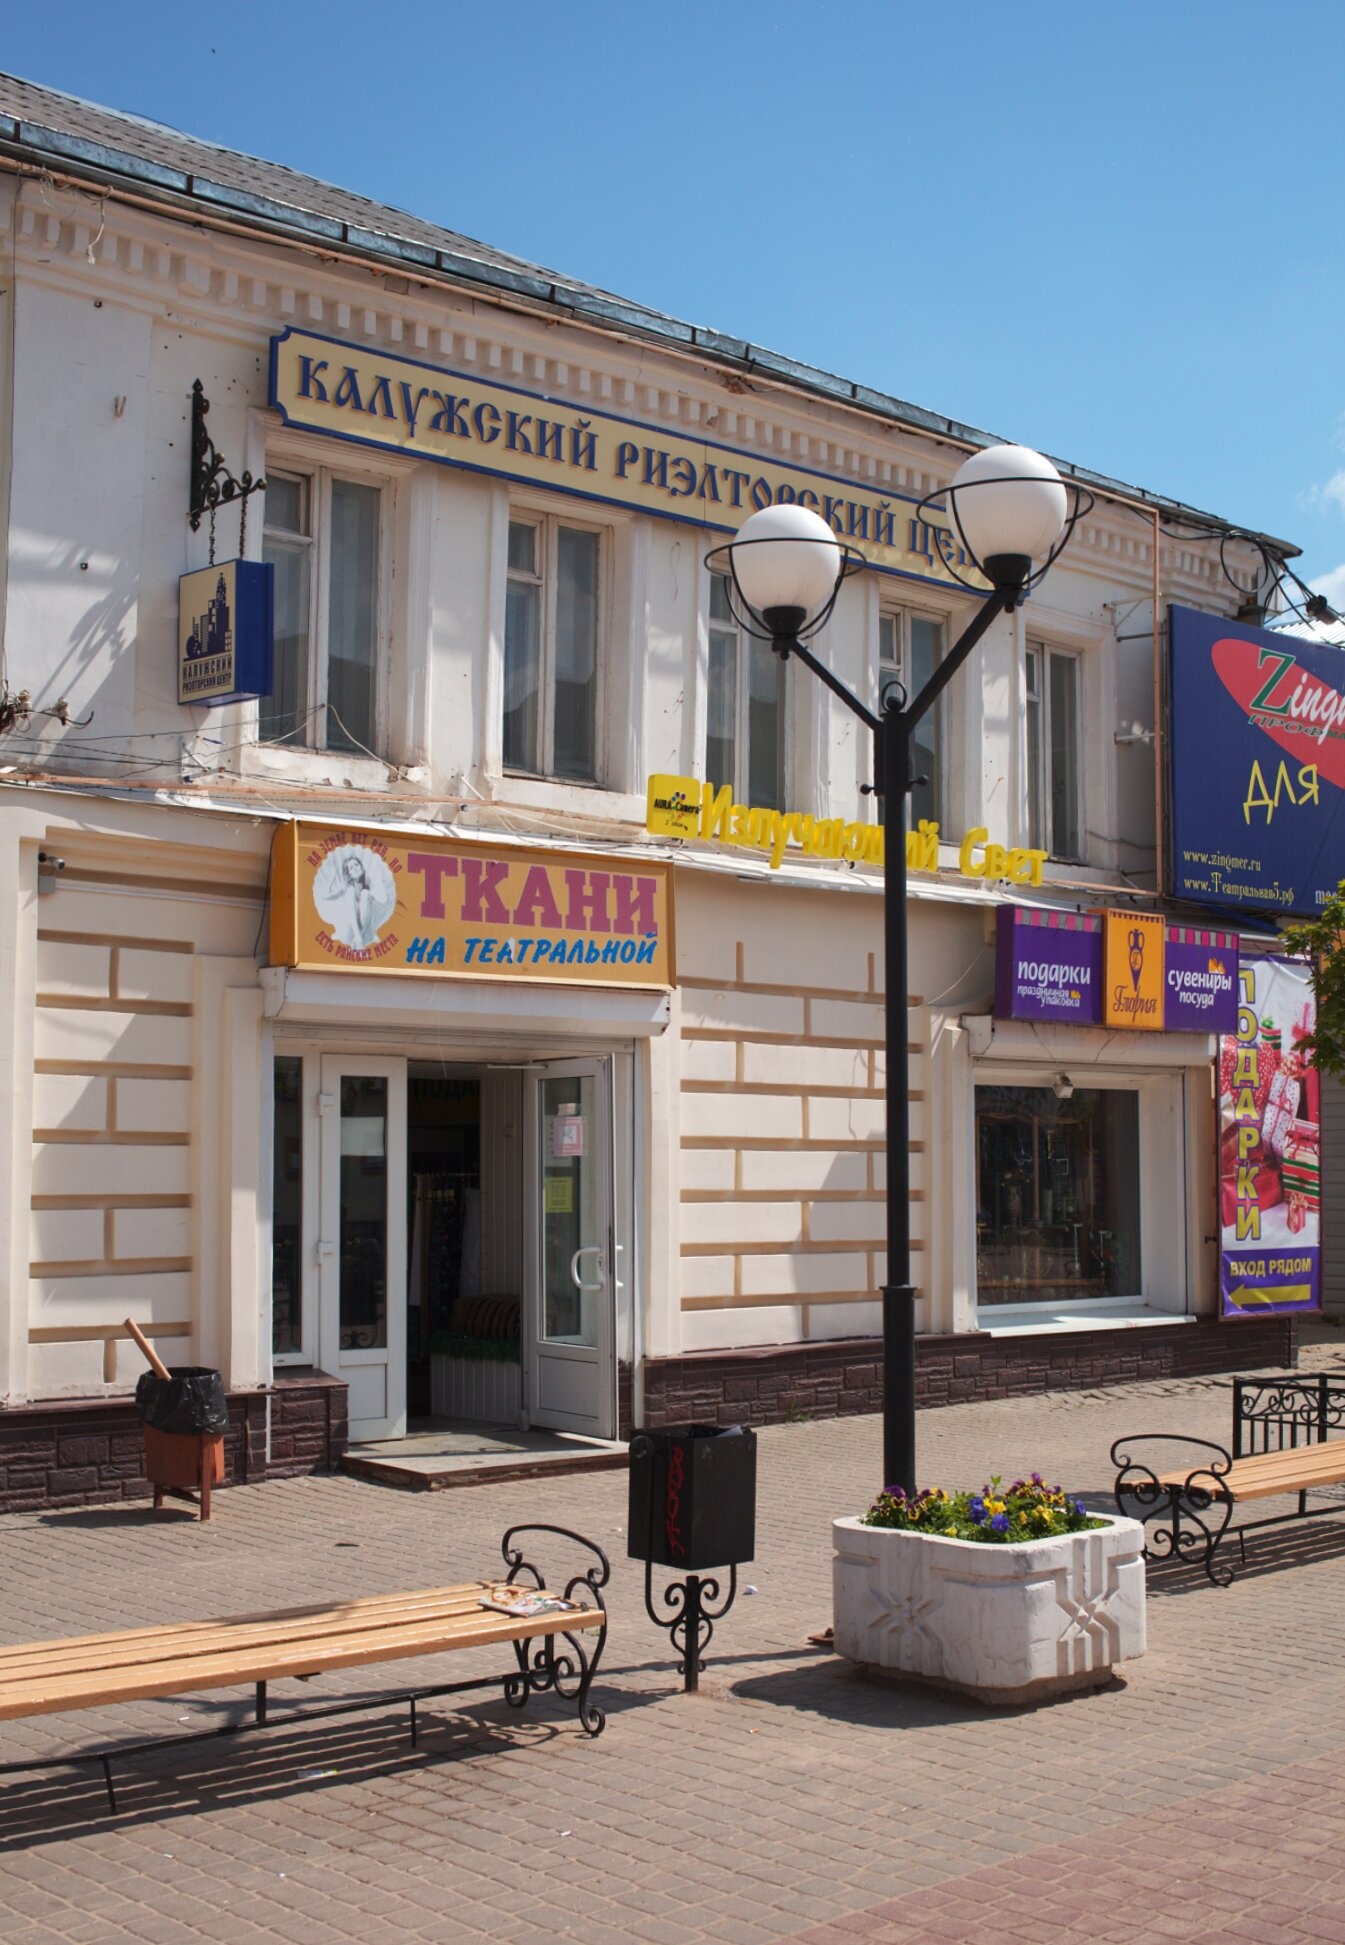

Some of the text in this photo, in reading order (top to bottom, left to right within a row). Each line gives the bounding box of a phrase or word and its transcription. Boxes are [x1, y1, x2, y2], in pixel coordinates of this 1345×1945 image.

[297, 355, 598, 471] КАЛУЖСКИЙ
[183, 655, 232, 681] КАЛУЖСКИЙ
[1243, 759, 1319, 825] ДЛЯ
[307, 850, 322, 867] НА
[319, 831, 346, 854] ЗЕМЛЕ
[351, 831, 368, 846] НЕТ
[389, 857, 402, 874] НО
[959, 826, 1048, 887] Свет
[1183, 850, 1261, 873] www.zingmer.ru
[407, 852, 658, 937] ТКАНИ
[315, 931, 334, 956] ЕСТЬ
[374, 933, 399, 958] МЕСТА
[406, 932, 658, 965] НА ТЕАТРАЛЬНОЙ
[1017, 961, 1091, 988] подарки
[1168, 969, 1232, 994] сувениры
[1040, 994, 1080, 1007] упаковка
[1179, 991, 1214, 1008] посуда
[1233, 967, 1261, 1242] ПОДАРКИ
[1230, 1258, 1312, 1278] ВХОД РЯДОМ
